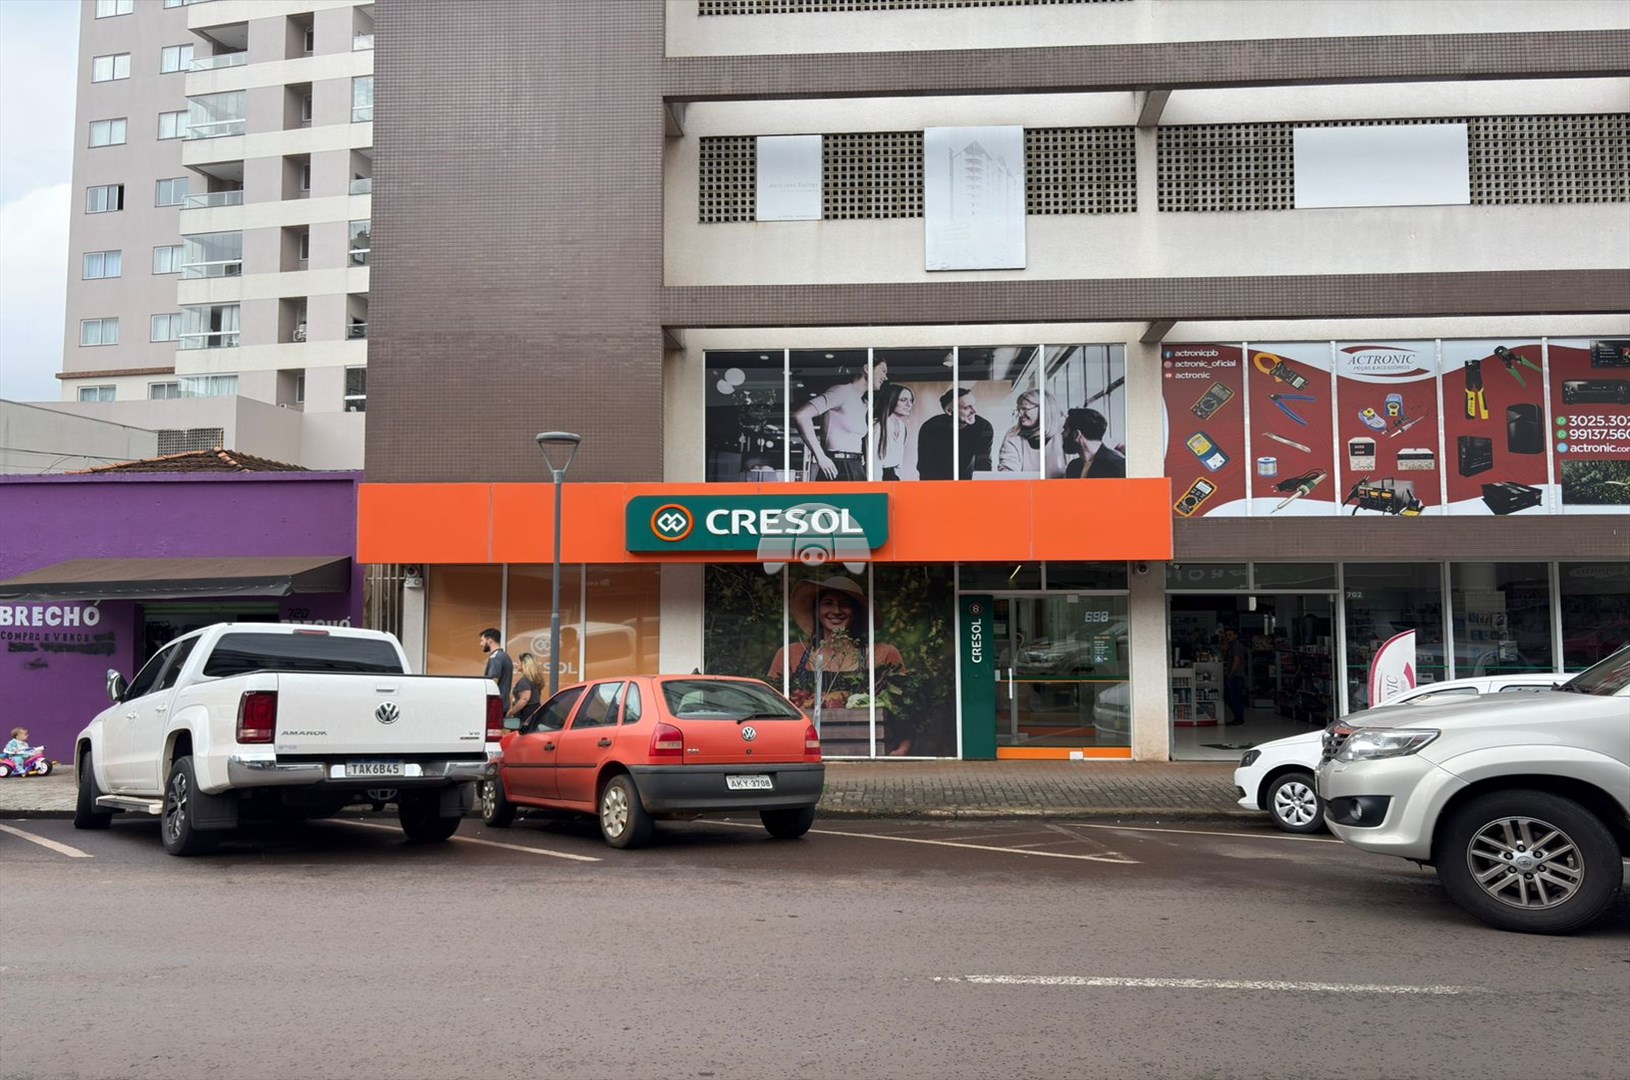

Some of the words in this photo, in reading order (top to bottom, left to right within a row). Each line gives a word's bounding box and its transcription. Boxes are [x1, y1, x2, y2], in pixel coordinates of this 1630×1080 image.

[1175, 349, 1219, 358] actronicpb
[1347, 354, 1416, 365] ACTRONIC
[1175, 360, 1237, 369] actronic_oficial
[1175, 371, 1211, 379] actronic
[705, 508, 864, 535] CRESOL
[0, 599, 101, 627] BRECHÓ
[1085, 611, 1109, 623] 698
[0, 630, 40, 642] COMPRA
[44, 633, 50, 642] E
[971, 618, 983, 664] CRESOL
[351, 763, 400, 775] TAK6B45
[731, 779, 771, 788] AKY-3708
